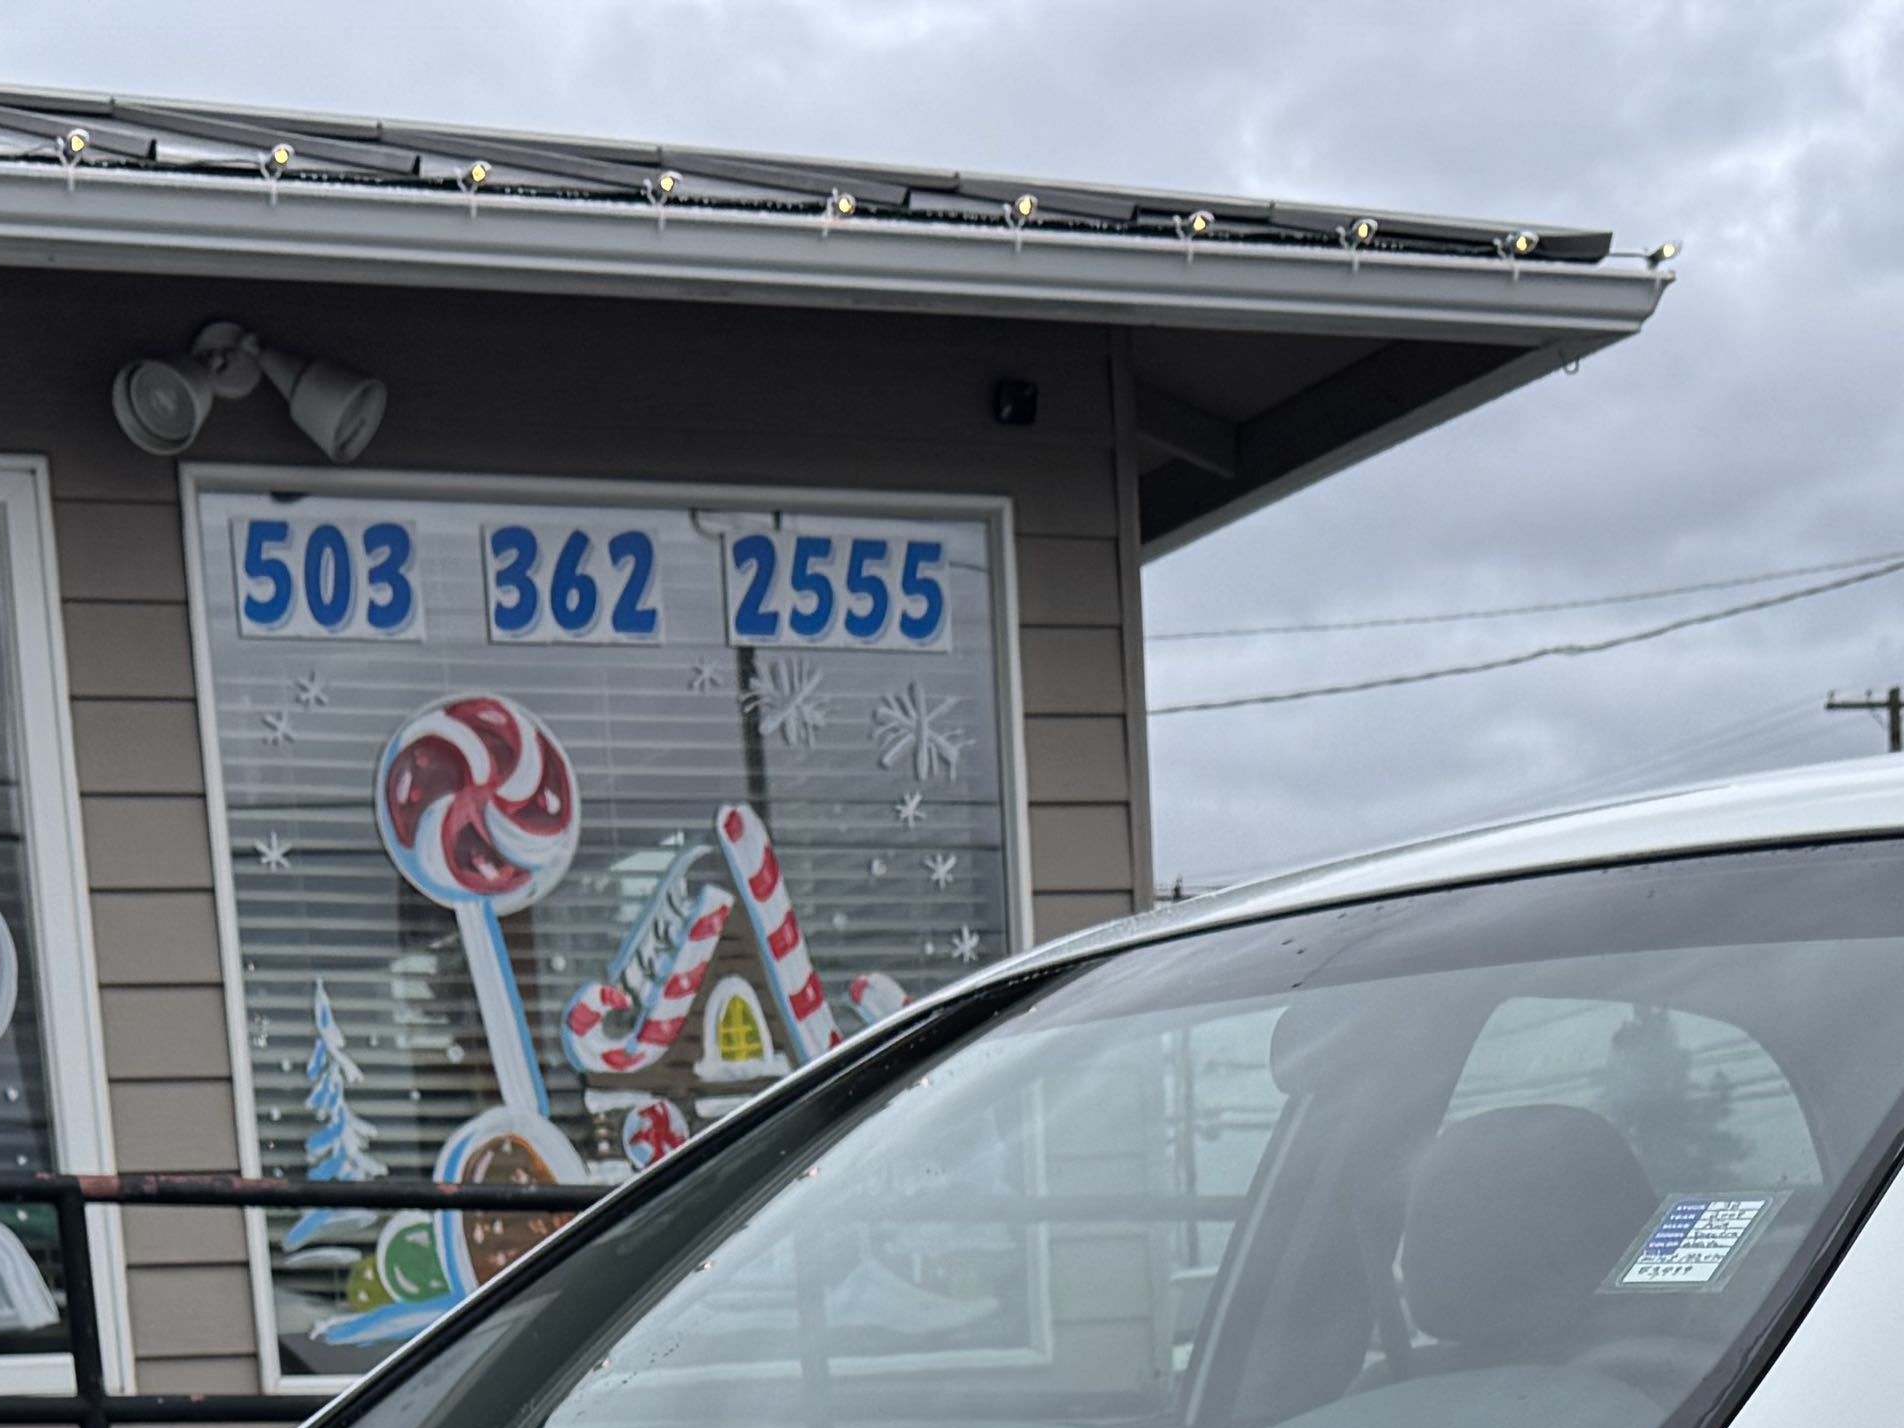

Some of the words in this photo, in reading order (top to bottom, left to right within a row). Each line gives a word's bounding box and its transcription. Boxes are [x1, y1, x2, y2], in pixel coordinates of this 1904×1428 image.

[242, 519, 416, 632] 503
[490, 525, 659, 636] 362
[732, 534, 946, 642] 2555
